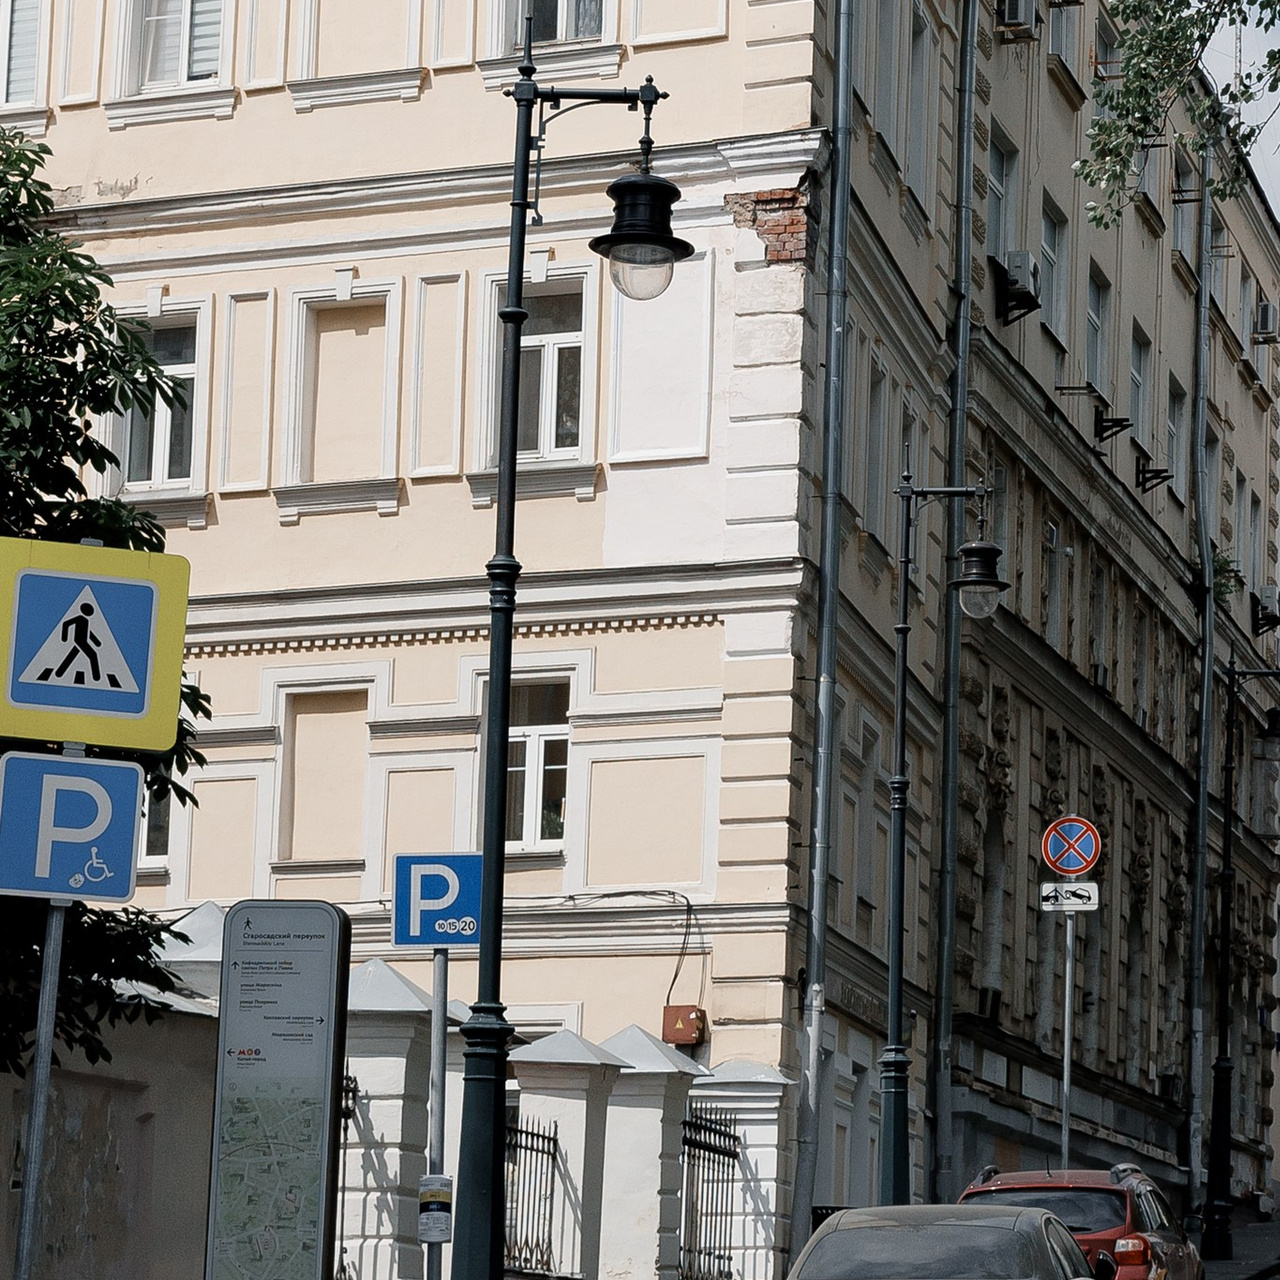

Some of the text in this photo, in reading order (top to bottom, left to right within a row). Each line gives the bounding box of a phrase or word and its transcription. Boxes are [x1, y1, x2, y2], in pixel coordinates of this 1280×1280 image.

[35, 773, 113, 878] P
[410, 864, 460, 936] P
[242, 932, 325, 941] Старосадский переулок
[448, 922, 458, 930] 15
[460, 920, 476, 931] 20
